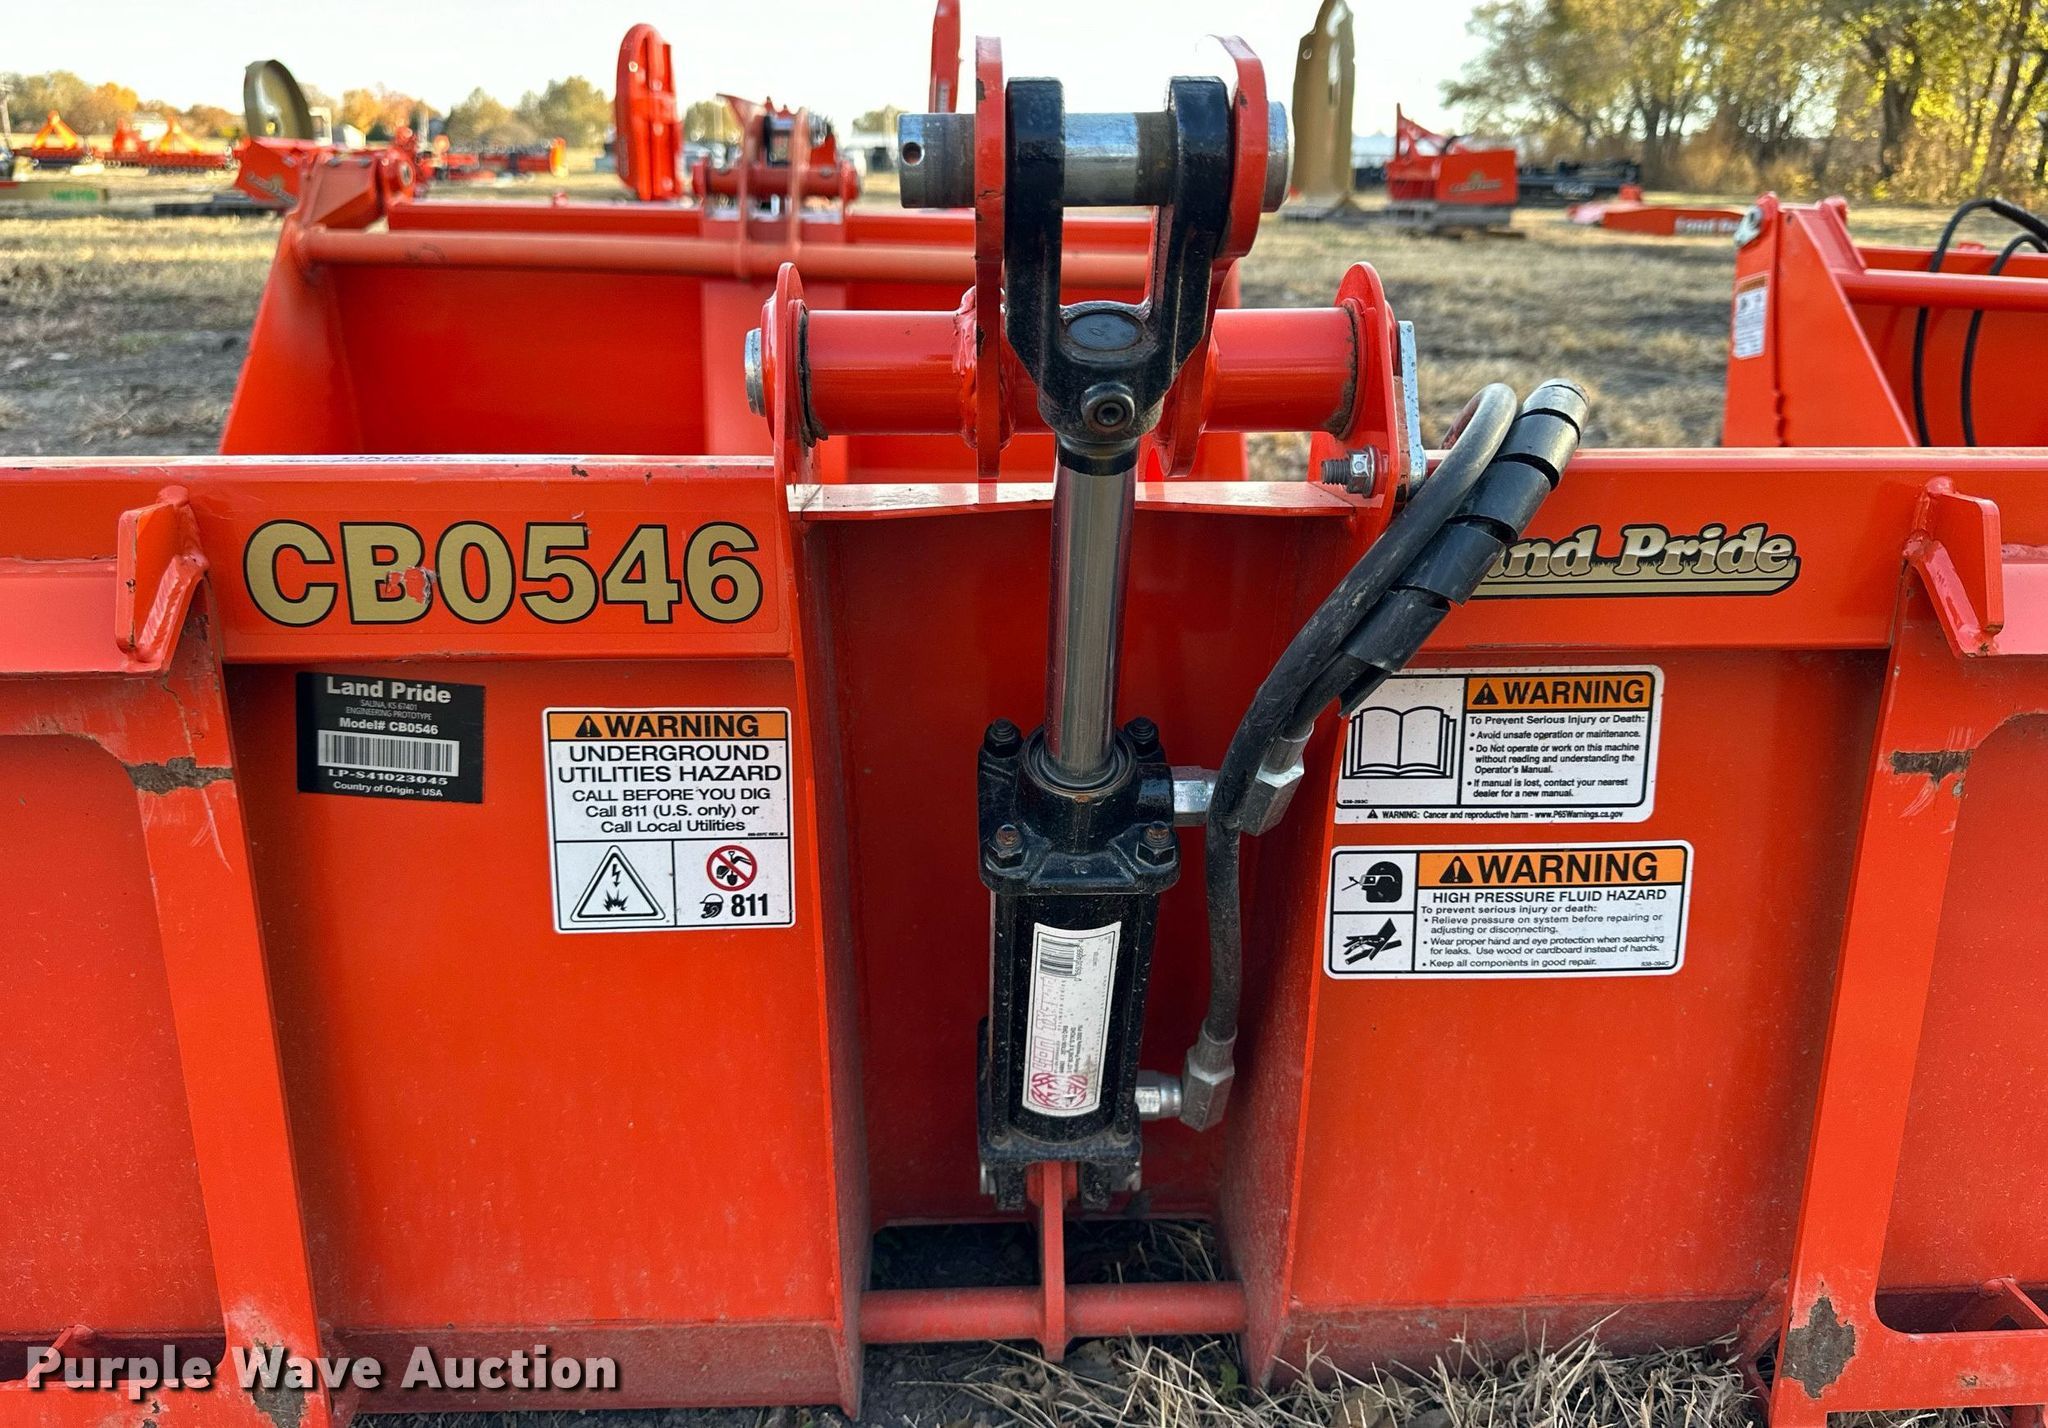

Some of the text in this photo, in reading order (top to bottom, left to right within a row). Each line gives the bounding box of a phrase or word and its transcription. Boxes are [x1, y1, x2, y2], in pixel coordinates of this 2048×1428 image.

[1613, 523, 1797, 574] Pride
[243, 519, 764, 627] CB0546
[326, 676, 452, 704] Land Pride
[1503, 680, 1645, 704] WARNING
[361, 699, 386, 709] SALINA,
[387, 702, 398, 710] KS
[346, 707, 432, 721] ENGINEERING PROTOTYPE
[1470, 714, 1645, 725] To Prevent Serious Injury or Death:
[339, 717, 439, 735] Model# CB0546
[604, 715, 759, 737] WARNING
[1477, 730, 1501, 739] Avoid
[1503, 730, 1532, 739] unsafe
[1533, 730, 1573, 740] operation
[1586, 730, 1641, 738] maintenance.
[569, 744, 769, 762] UNDERGROUND
[1476, 745, 1488, 753] Do
[1490, 744, 1504, 752] Not
[1507, 744, 1538, 754] operate
[1552, 744, 1572, 752] work
[1587, 743, 1602, 751] this
[1604, 743, 1639, 751] machine
[1475, 754, 1635, 764] without reading and understanding the
[558, 765, 782, 783] UTILITIES HAZARD
[1475, 765, 1553, 775] Operator's Manual.
[328, 769, 448, 786] LP-S41023045
[1474, 778, 1628, 788] If manual is lost, contact your nearest
[333, 781, 372, 793] Country
[374, 784, 383, 792] of
[384, 785, 415, 797] Origin
[422, 788, 443, 797] USA
[572, 788, 771, 801] CALL BEFORE YOU DIG
[1473, 789, 1499, 797] dealer
[1501, 789, 1513, 797] for
[1541, 789, 1574, 797] manual.
[585, 803, 760, 819] Call 811 (U.S. only) or
[1382, 811, 1420, 819] WARNING:
[1423, 810, 1449, 819] Cancer
[1450, 810, 1463, 819] and
[1464, 810, 1509, 820] reproductive
[1511, 810, 1529, 819] harm
[1535, 810, 1623, 820] www.P65Warnings.ca.gov
[601, 819, 746, 833] Call Local Utilities
[1476, 852, 1658, 884] WARNING
[1433, 889, 1667, 904] HIGH PRESSURE FLUID HAZARD
[731, 893, 768, 917] 811
[1421, 906, 1433, 914] To
[1435, 906, 1476, 915] prevent
[1478, 905, 1516, 914] serious
[1519, 905, 1548, 915] injury
[1564, 904, 1597, 913] death:
[1431, 916, 1468, 925] Relieve
[1471, 916, 1514, 926] pressure
[1533, 916, 1569, 926] system
[1572, 915, 1603, 923] before
[1606, 914, 1649, 924] repairing
[1431, 926, 1474, 936] adjusting
[1489, 925, 1559, 935] disconnecting.
[1431, 934, 1665, 947] Wear proper hand and eye protection when searching
[1430, 947, 1442, 955] for
[1445, 947, 1471, 955] leaks.
[1476, 946, 1494, 955] Use
[1496, 946, 1522, 954] wood
[1535, 946, 1583, 954] cardboard
[1584, 945, 1617, 953] instead
[1630, 944, 1659, 952] hands.
[1430, 959, 1454, 968] Keep
[1456, 959, 1468, 967] all
[1470, 959, 1528, 968] components
[1542, 958, 1566, 967] good
[1568, 958, 1597, 968] repair.
